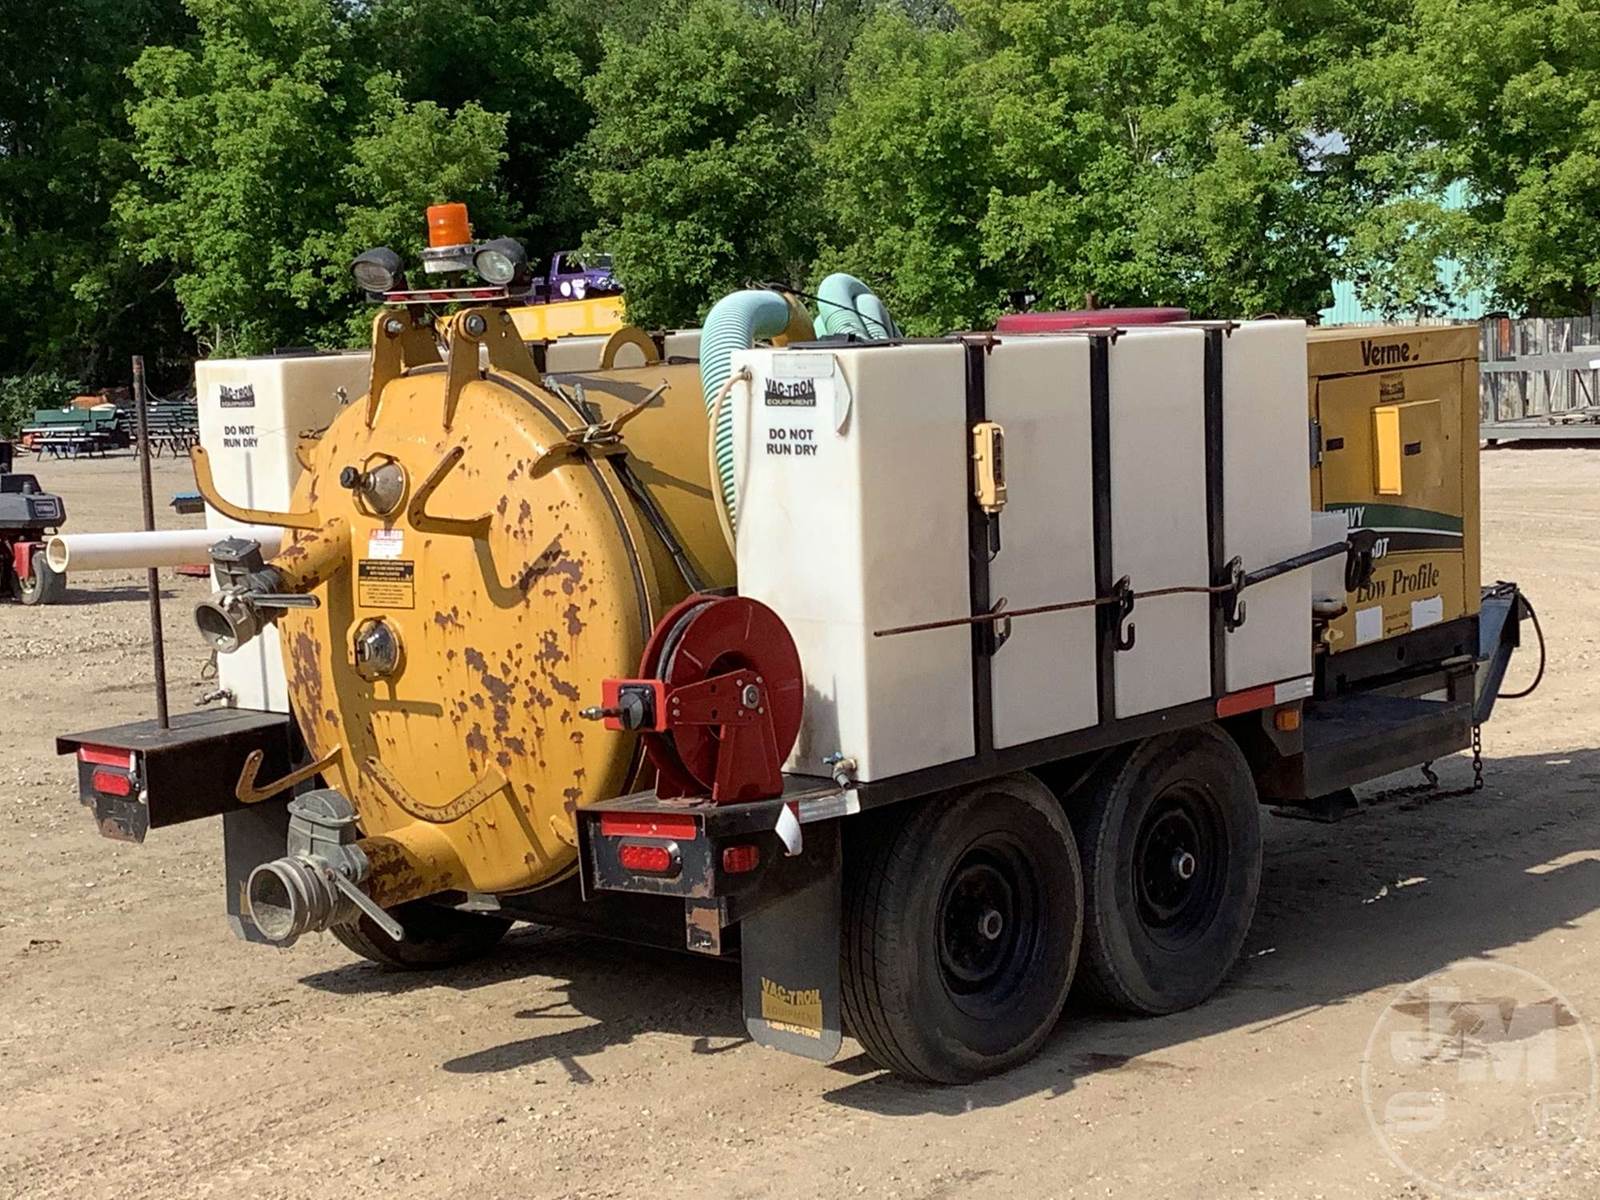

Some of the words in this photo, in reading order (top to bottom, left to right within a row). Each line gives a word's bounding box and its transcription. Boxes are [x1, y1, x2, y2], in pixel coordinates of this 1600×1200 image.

[1361, 340, 1419, 366] Verme
[765, 377, 815, 398] VAC-TRON
[224, 426, 237, 436] DO
[239, 425, 255, 436] NOT
[769, 428, 786, 440] DO
[790, 429, 813, 440] NOT
[224, 438, 241, 448] RUN
[243, 438, 258, 448] DRY
[767, 443, 791, 455] RUN
[795, 444, 818, 456] DRY
[1391, 562, 1440, 596] Profile
